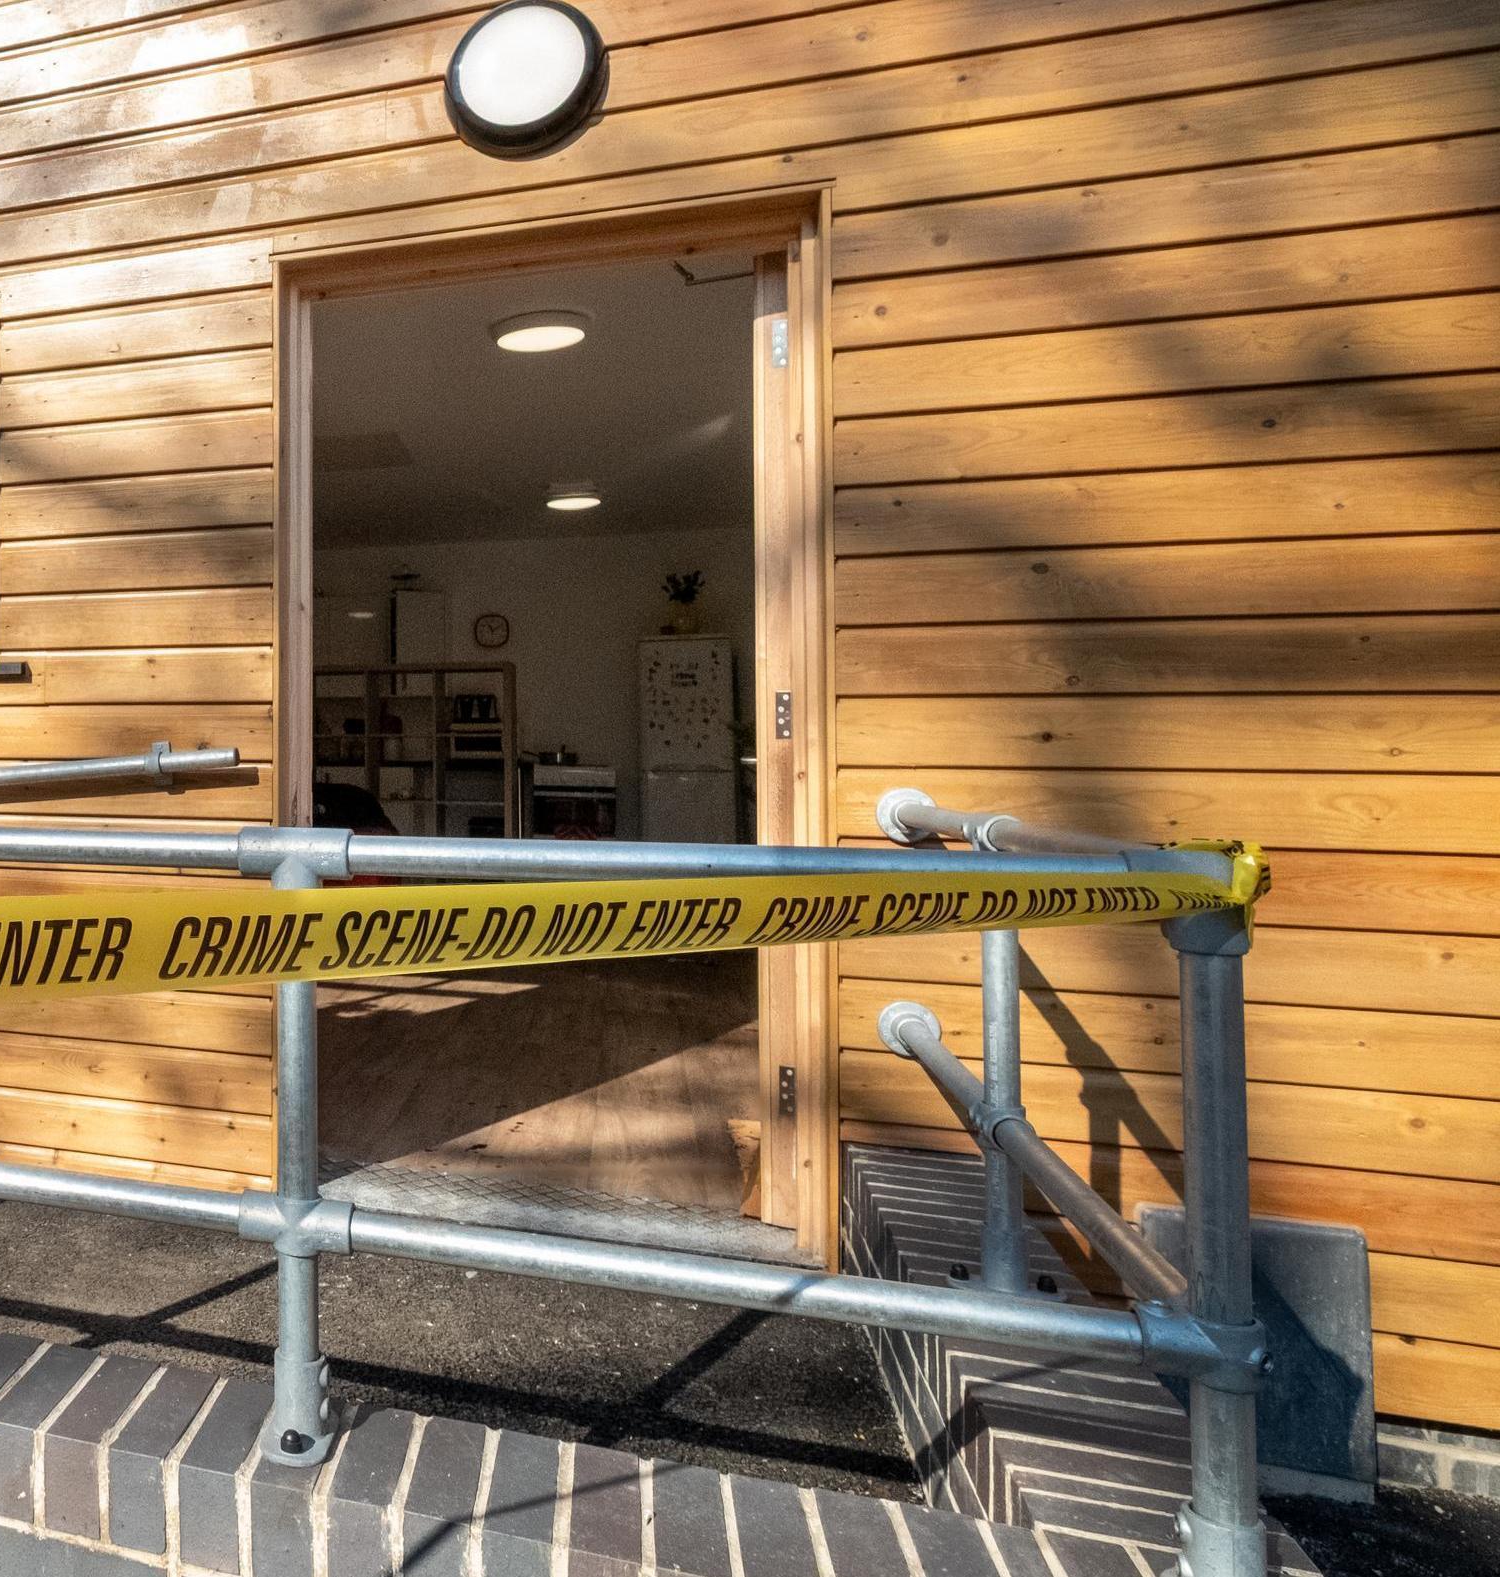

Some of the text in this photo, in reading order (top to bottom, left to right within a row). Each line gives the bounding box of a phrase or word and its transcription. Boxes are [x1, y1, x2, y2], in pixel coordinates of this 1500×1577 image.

[158, 912, 323, 980] CRIME
[319, 904, 536, 971] SCENE-DO
[529, 901, 627, 957] NOT
[612, 897, 742, 952] ENTER
[742, 895, 870, 944] CRIME
[1014, 888, 1078, 920] NOT
